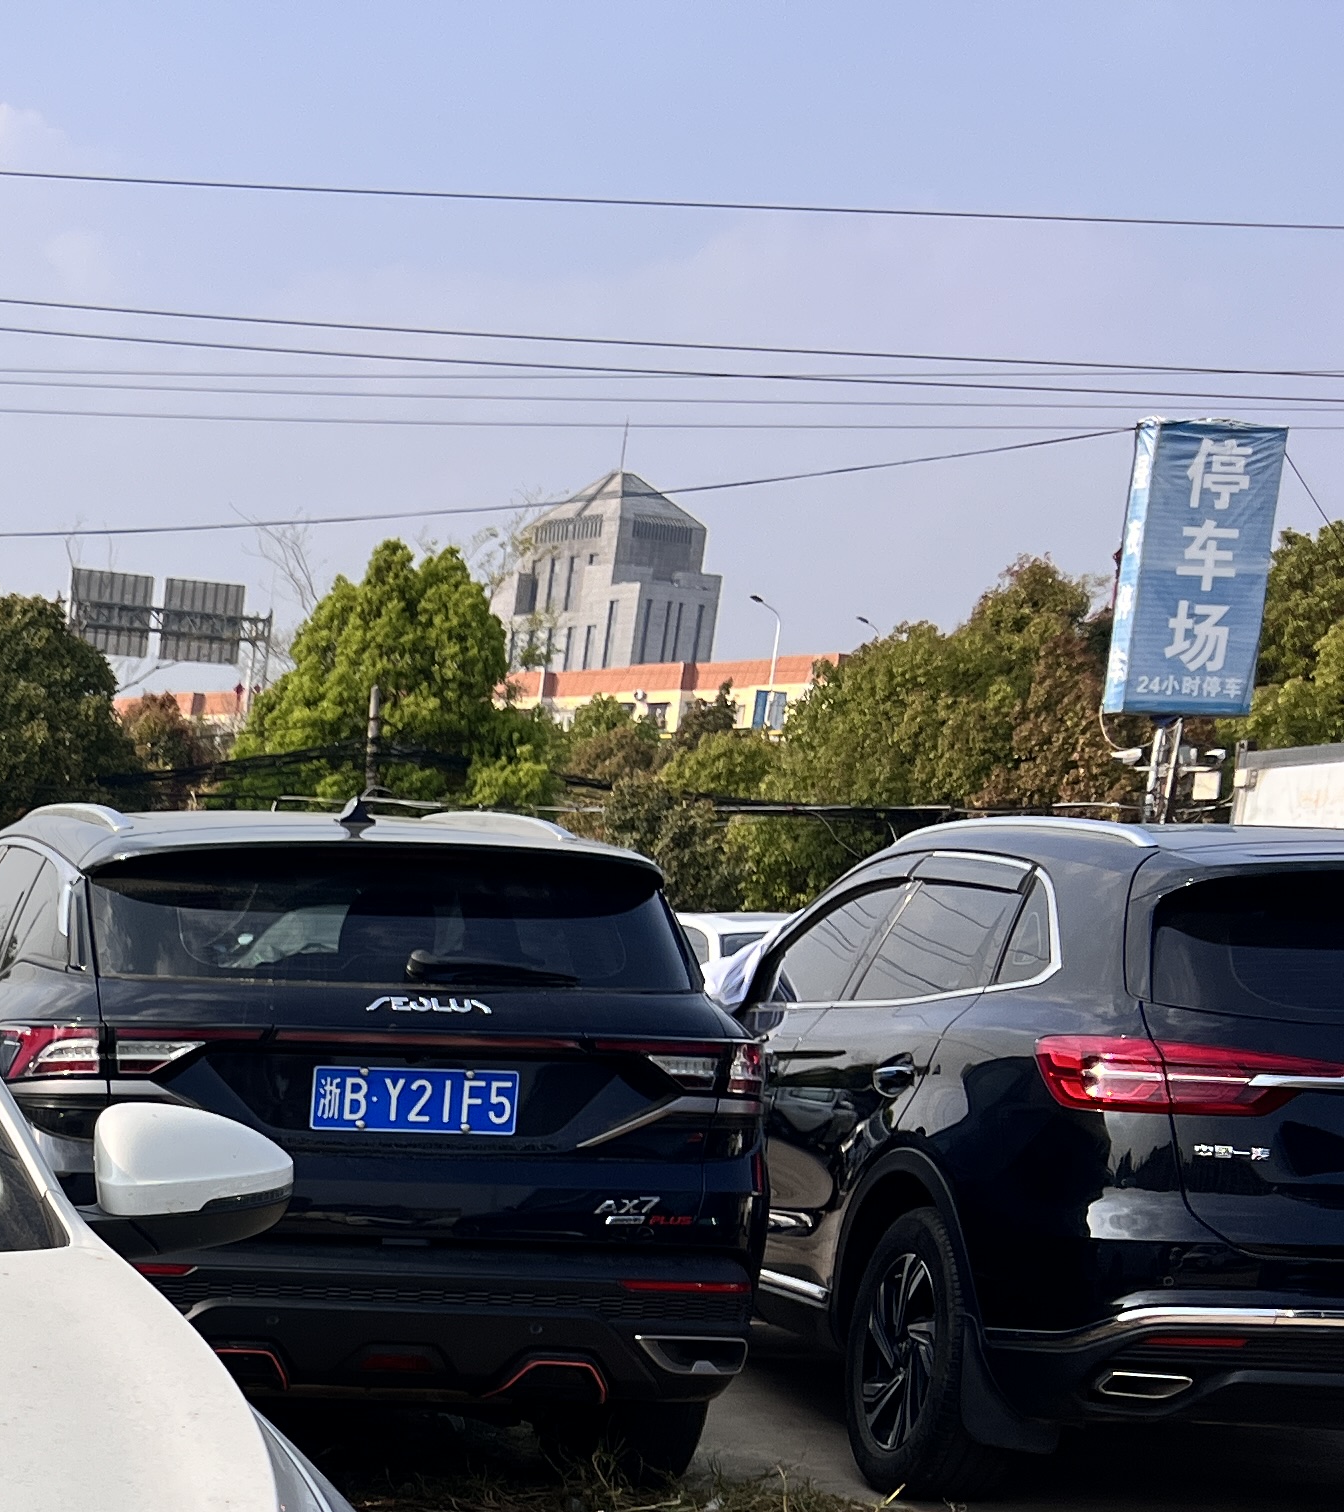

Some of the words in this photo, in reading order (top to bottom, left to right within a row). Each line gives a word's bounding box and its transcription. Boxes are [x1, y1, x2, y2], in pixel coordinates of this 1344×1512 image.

[1164, 437, 1252, 672] 停车场
[1135, 675, 1244, 699] 24小时停车
[594, 1196, 660, 1214] AX7
